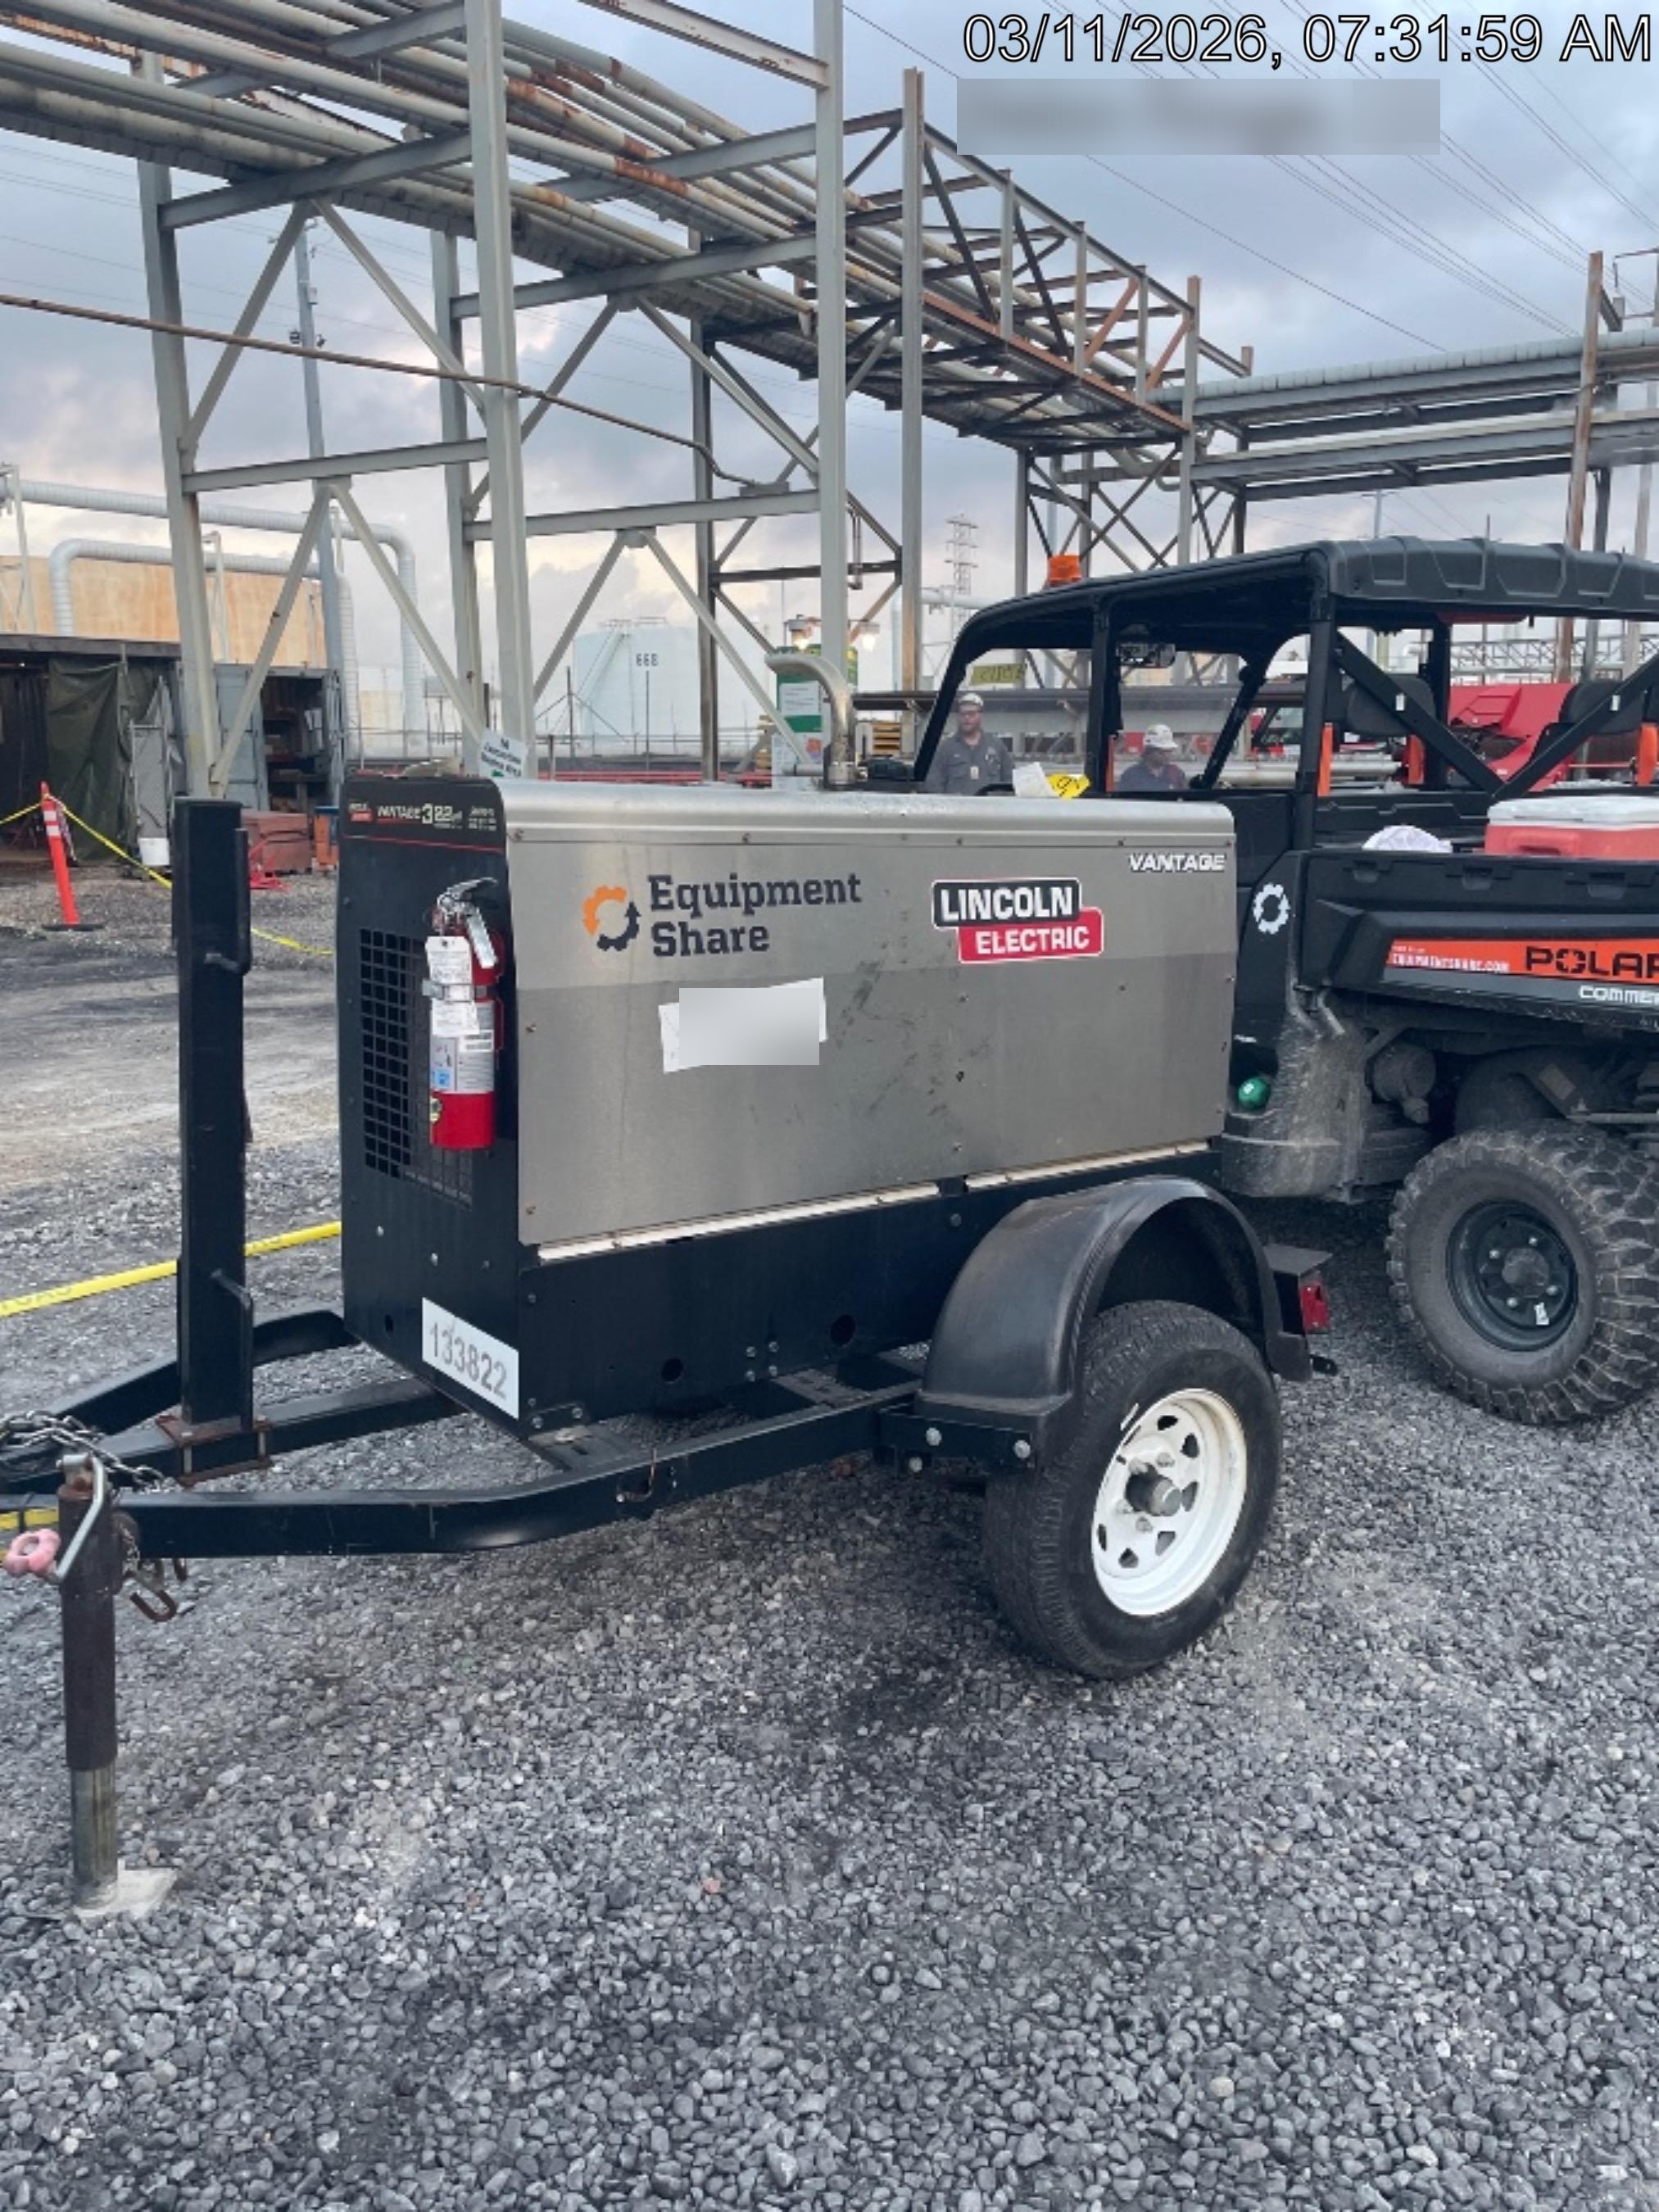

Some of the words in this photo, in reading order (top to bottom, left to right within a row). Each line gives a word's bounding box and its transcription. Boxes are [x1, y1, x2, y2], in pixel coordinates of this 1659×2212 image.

[1129, 853, 1226, 873] VANTAGE
[649, 873, 861, 917] Equipment
[940, 887, 1072, 922] LINCOLN
[652, 921, 768, 957] Share
[976, 927, 1090, 955] ELECTRIC
[429, 1322, 507, 1401] 133822
